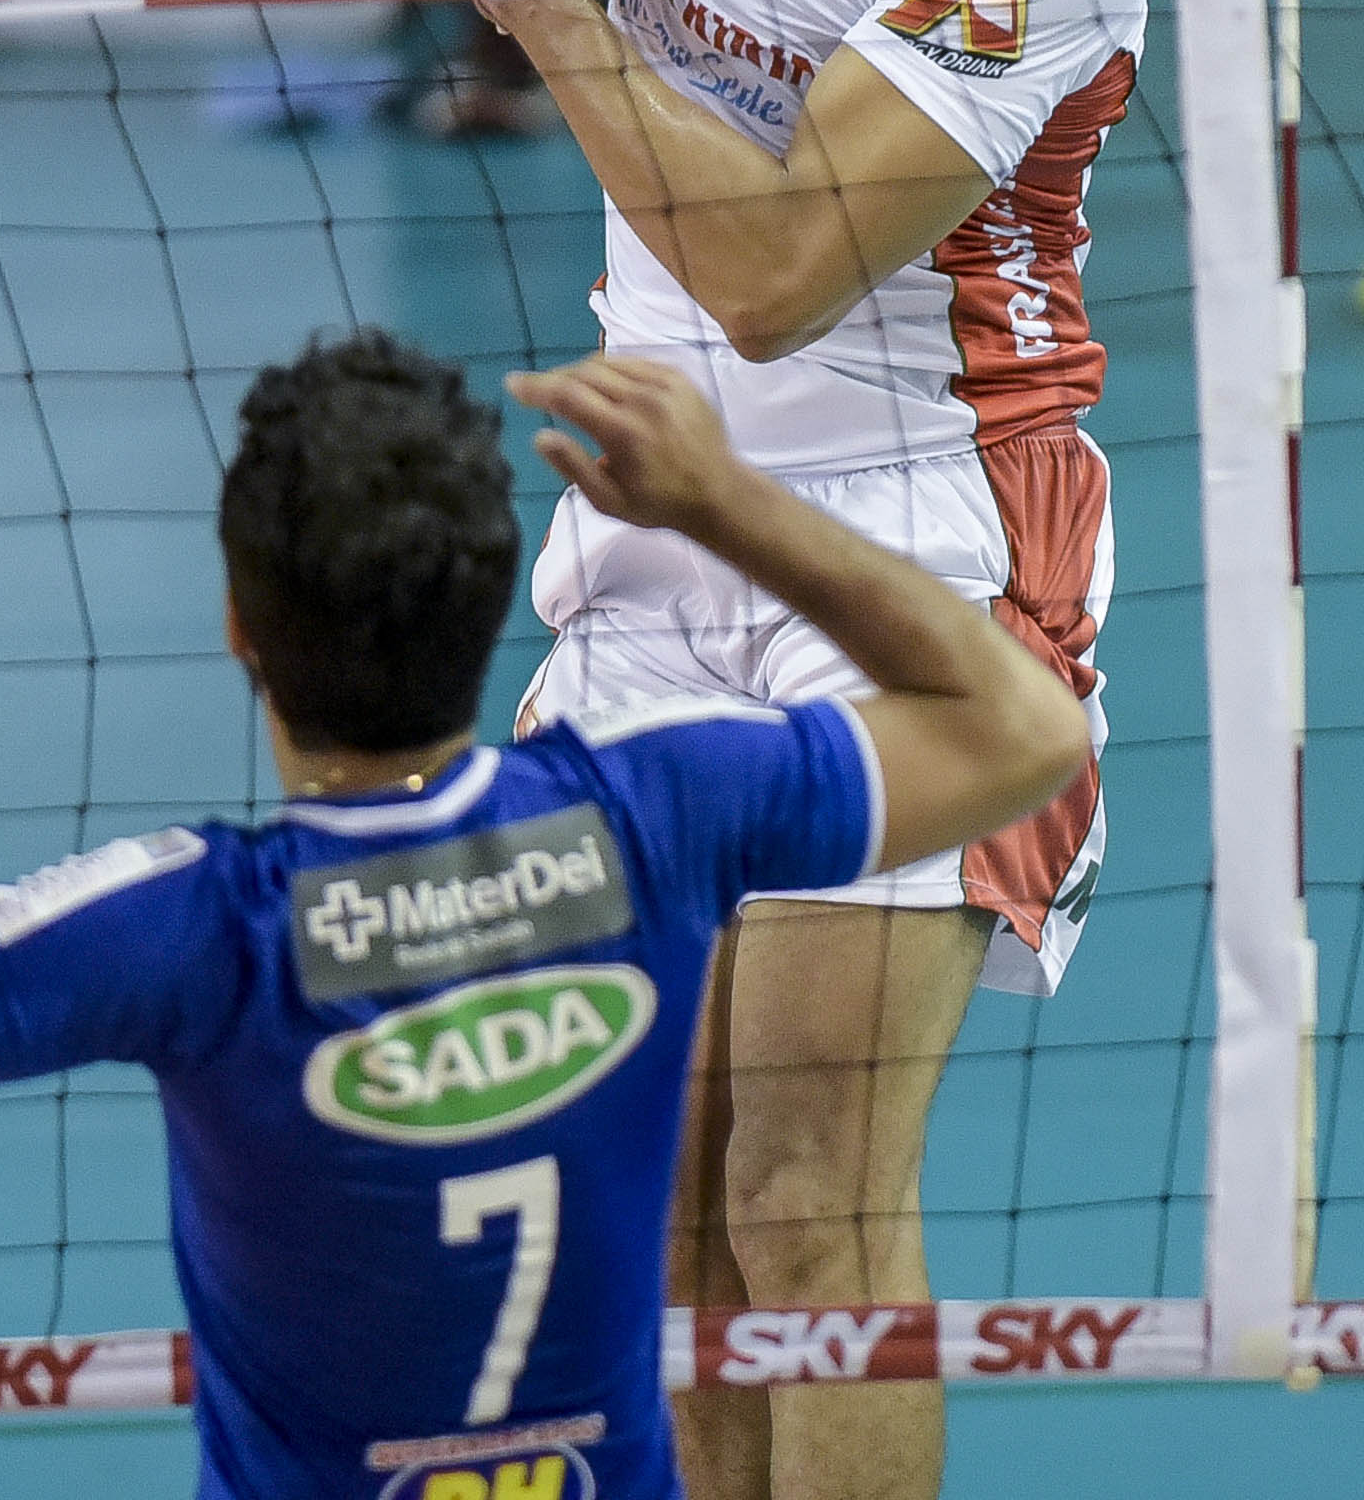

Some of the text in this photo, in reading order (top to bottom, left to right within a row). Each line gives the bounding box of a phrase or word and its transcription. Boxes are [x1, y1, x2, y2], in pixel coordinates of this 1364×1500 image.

[938, 50, 1009, 78] DRINK
[356, 987, 614, 1108] SADA
[440, 1155, 561, 1426] 7
[718, 1309, 899, 1380] SKY
[970, 1305, 1142, 1373] SKY
